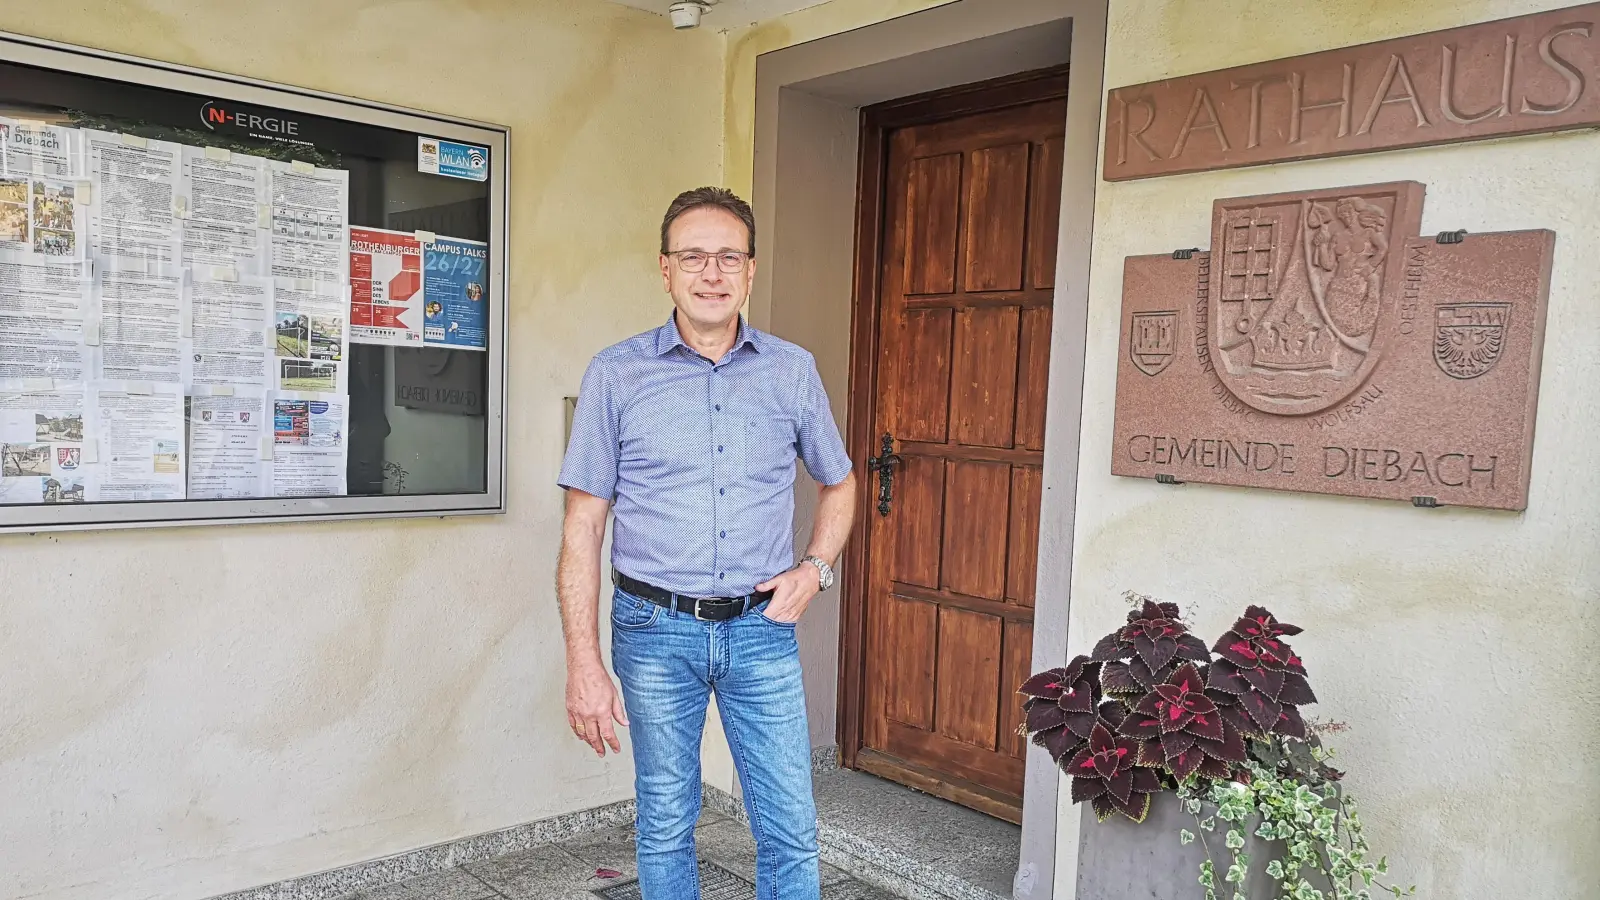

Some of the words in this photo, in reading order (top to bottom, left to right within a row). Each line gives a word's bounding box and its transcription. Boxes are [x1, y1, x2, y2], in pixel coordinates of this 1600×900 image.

[1113, 21, 1594, 165] RATHAUS
[209, 107, 299, 136] N-ERGIE
[15, 134, 60, 149] Diebach
[440, 146, 464, 156] BAYERN
[440, 153, 470, 167] WLAN
[351, 239, 421, 256] ROTHENBURGER
[424, 242, 461, 255] CAMPUS
[462, 247, 487, 259] TALKS
[425, 251, 484, 276] 26/27
[1306, 383, 1384, 429] WOLFSAU
[1127, 433, 1296, 475] GEMEINDE
[1322, 446, 1500, 490] DIEBACH
